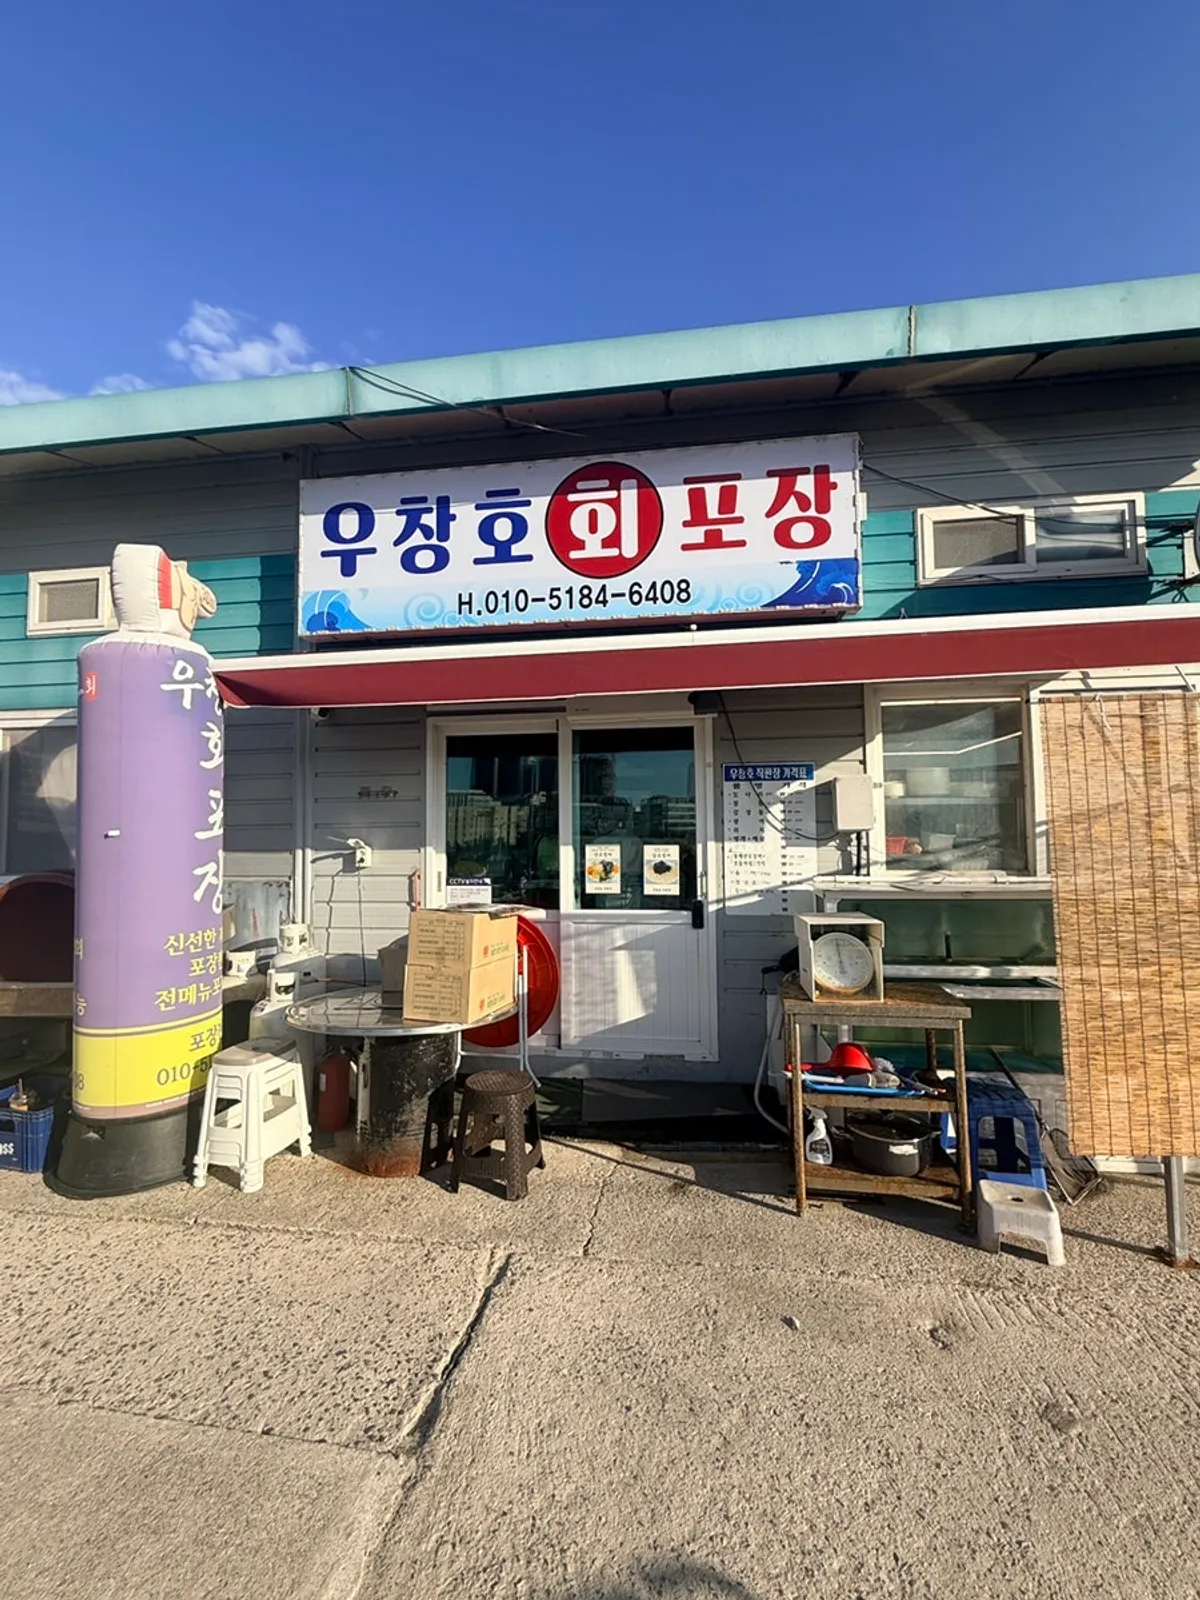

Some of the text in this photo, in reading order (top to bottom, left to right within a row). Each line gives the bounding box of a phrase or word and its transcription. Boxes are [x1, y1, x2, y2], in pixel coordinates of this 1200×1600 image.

[320, 464, 838, 578] 우창호 회 포장
[457, 579, 692, 617] H.010-5184-6408
[164, 927, 217, 957] 신선한
